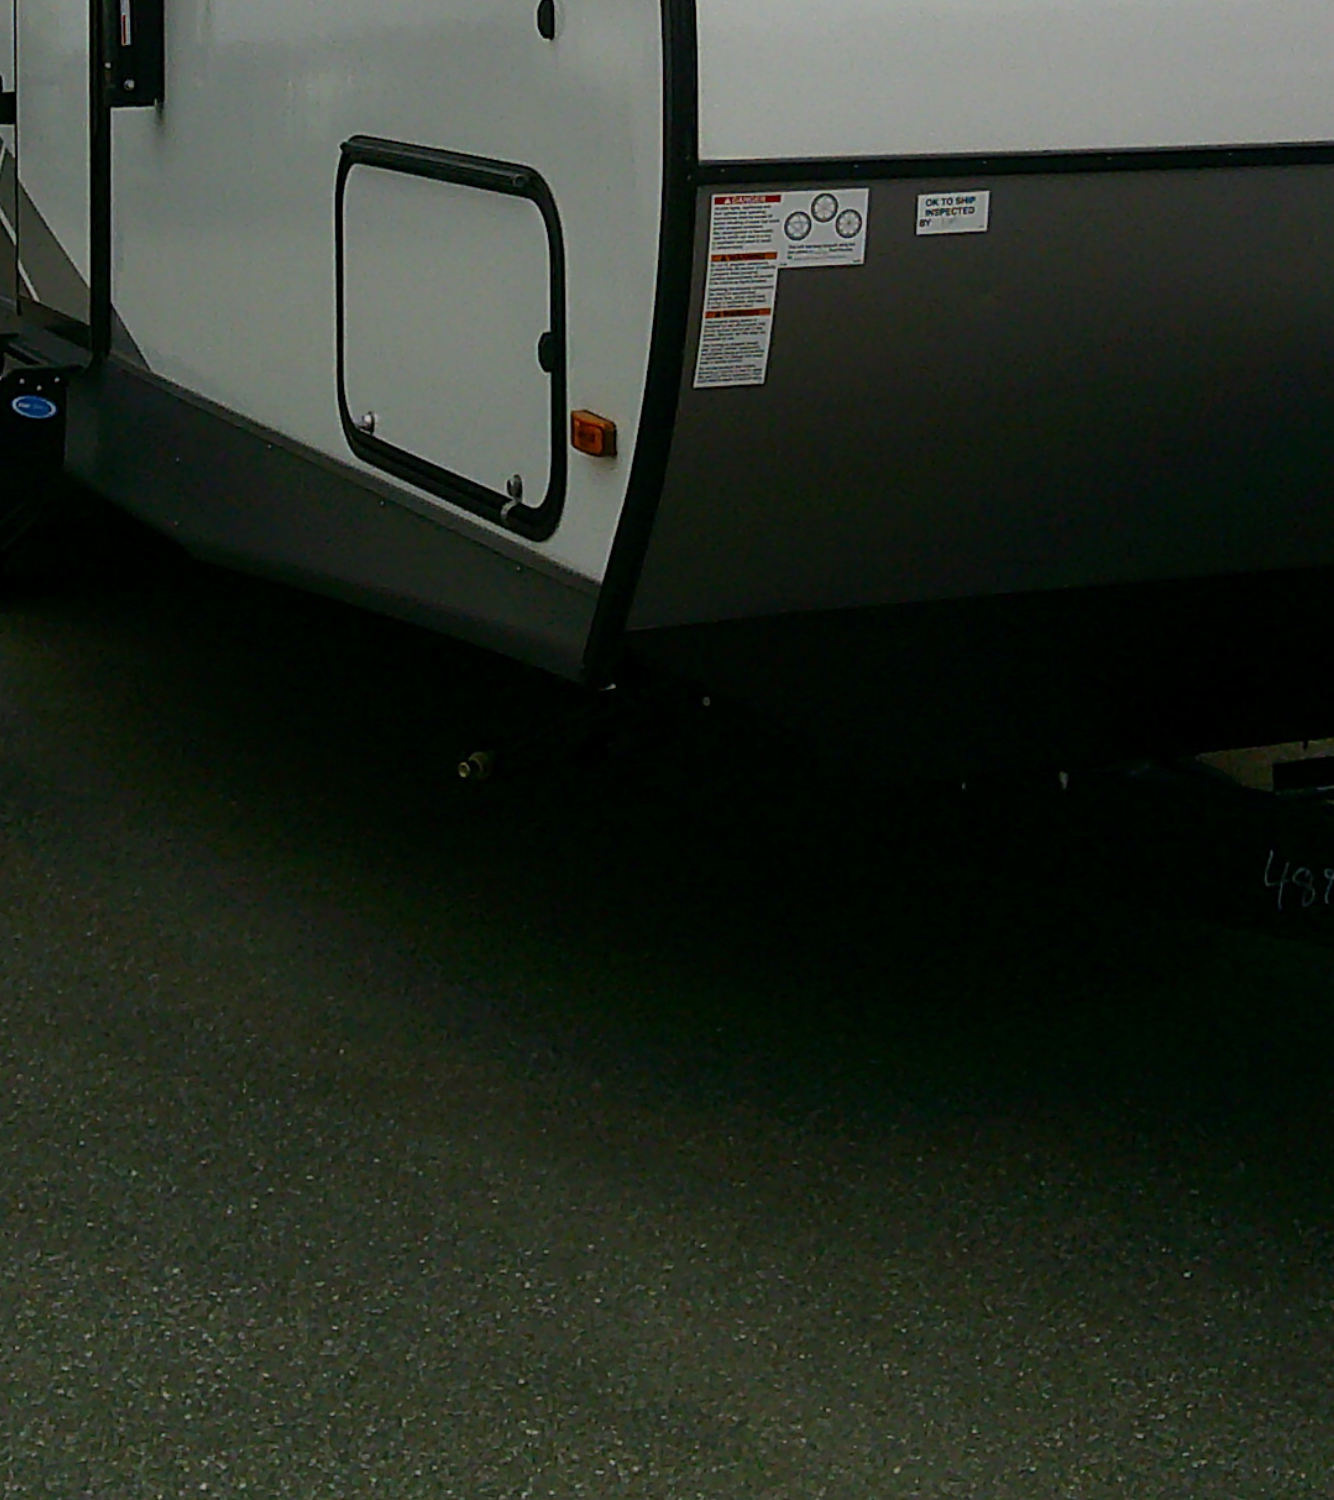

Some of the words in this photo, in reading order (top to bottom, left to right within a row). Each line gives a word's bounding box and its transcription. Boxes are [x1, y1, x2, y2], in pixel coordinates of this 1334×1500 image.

[925, 198, 939, 207] OK
[941, 197, 953, 206] TO
[955, 196, 976, 205] SHIP
[925, 206, 975, 216] INSPECTED
[919, 218, 932, 227] BY
